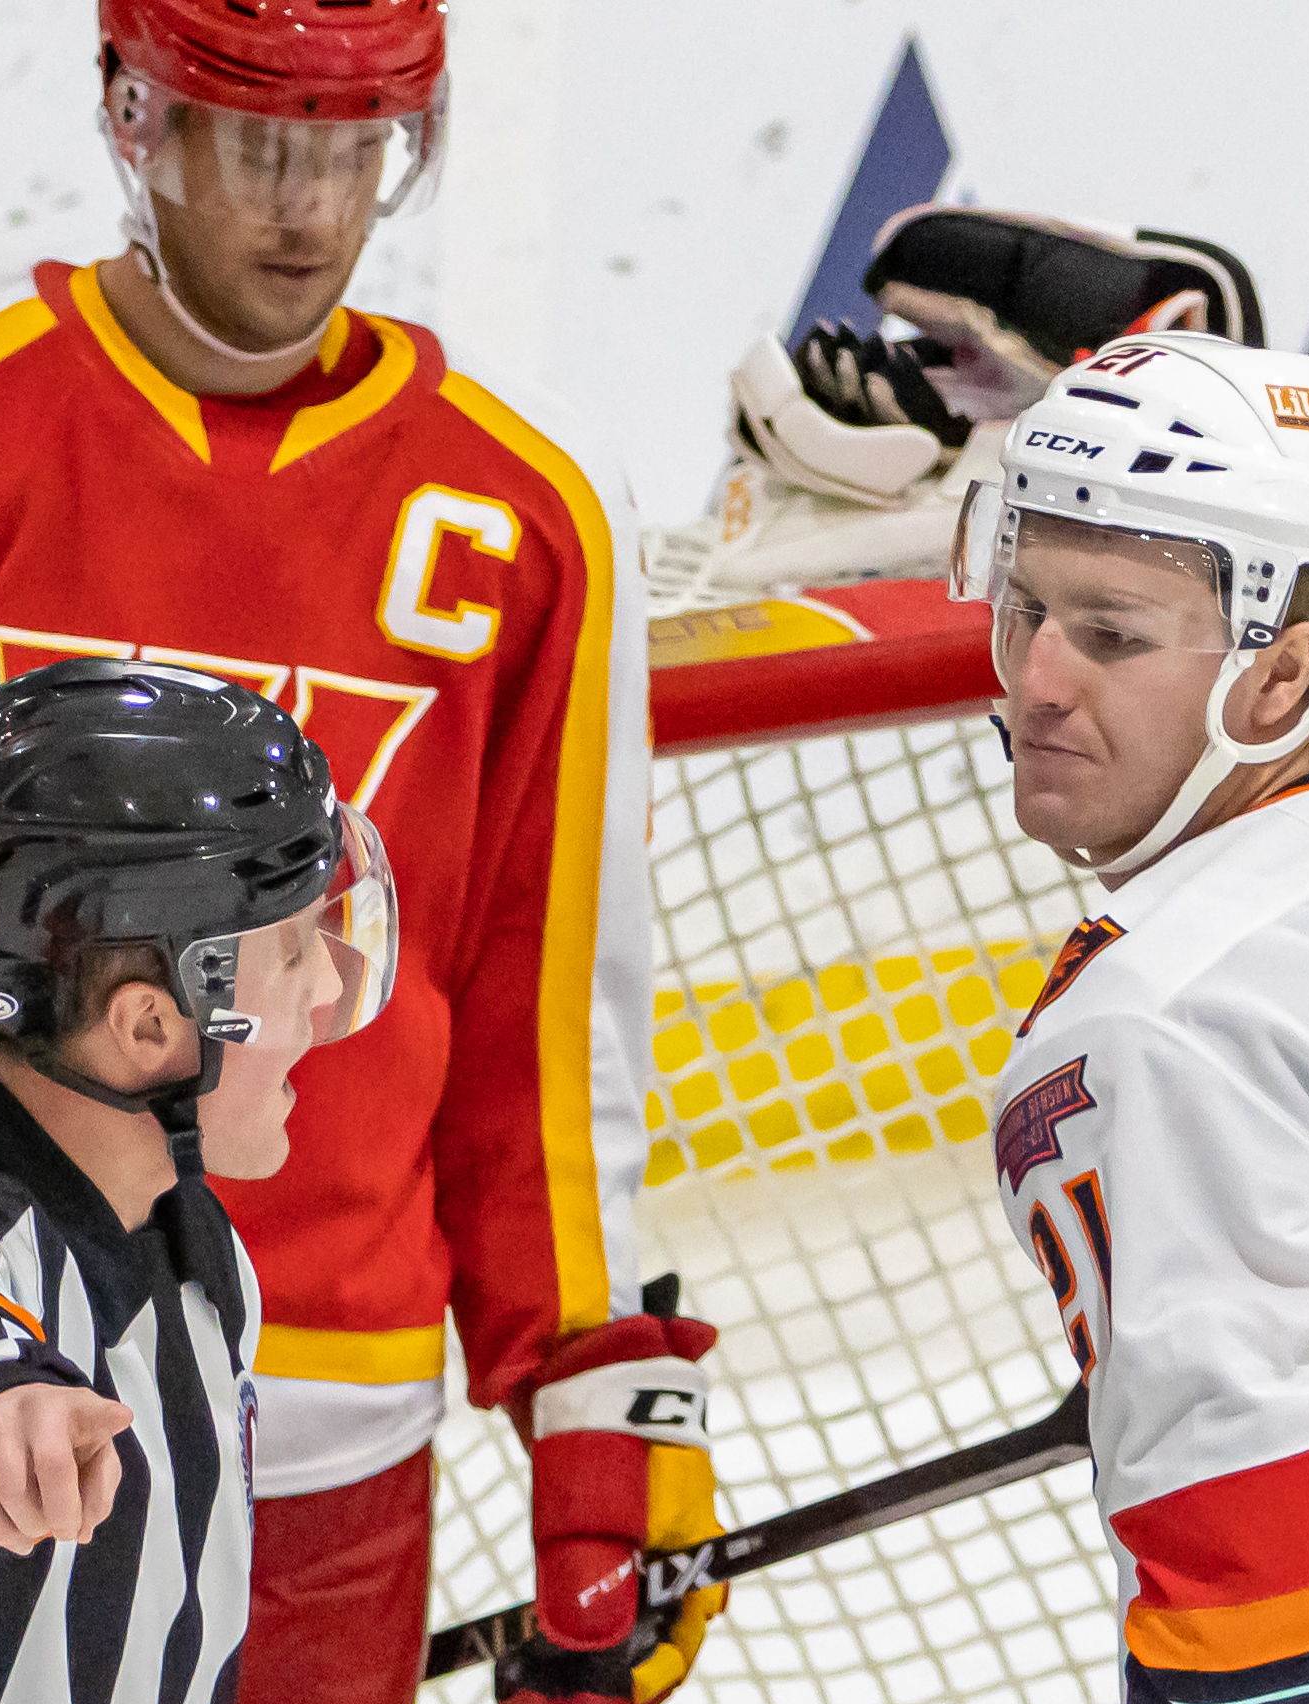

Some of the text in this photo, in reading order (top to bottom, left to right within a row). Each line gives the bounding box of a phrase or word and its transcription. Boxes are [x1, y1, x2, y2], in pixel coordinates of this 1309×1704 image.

[1025, 430, 1105, 459] CCM
[375, 483, 522, 664] C
[625, 1387, 708, 1427] C
